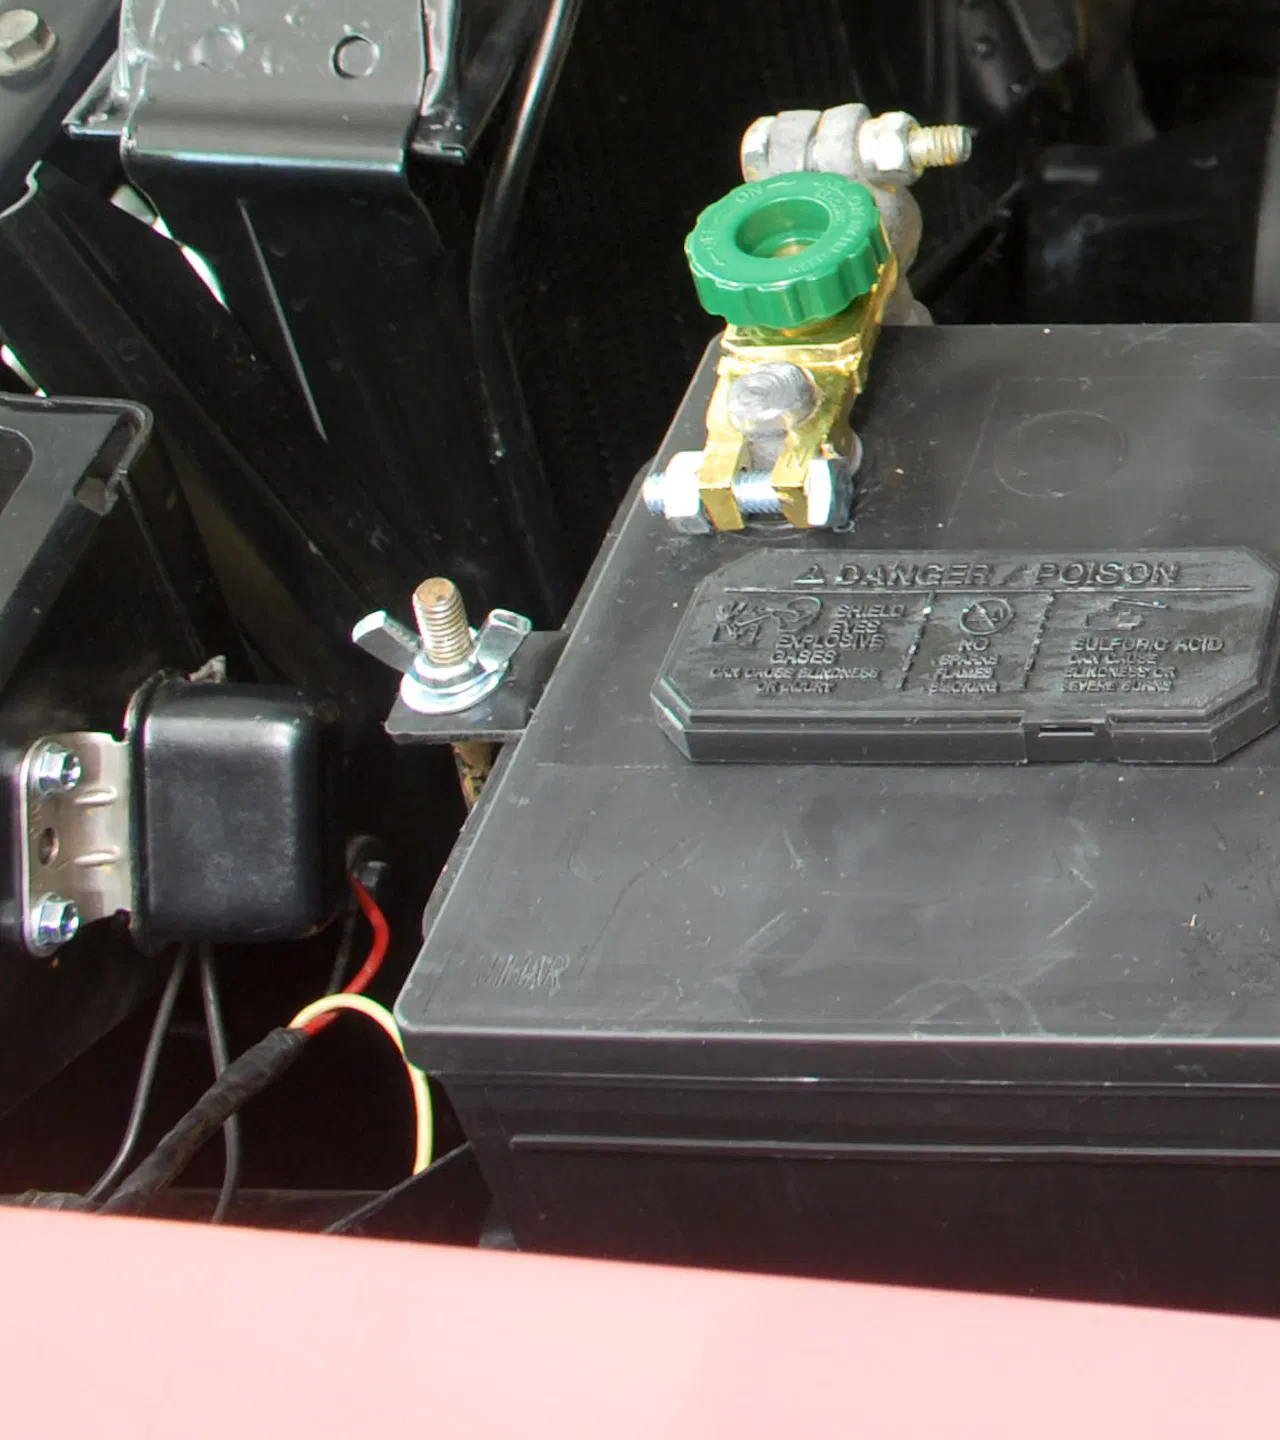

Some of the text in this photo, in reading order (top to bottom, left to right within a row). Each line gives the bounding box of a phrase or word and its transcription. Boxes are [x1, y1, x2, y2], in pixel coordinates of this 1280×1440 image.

[834, 562, 995, 587] DANGER
[1036, 561, 1182, 587] POISON
[835, 604, 907, 618] SHIELD
[828, 619, 881, 634] EYES
[774, 633, 887, 651] EXPLOSIVE
[957, 637, 990, 653] NO
[1071, 636, 1224, 653] SULFURIC ACID
[769, 649, 838, 665] GASES
[934, 667, 993, 681] FLAMES
